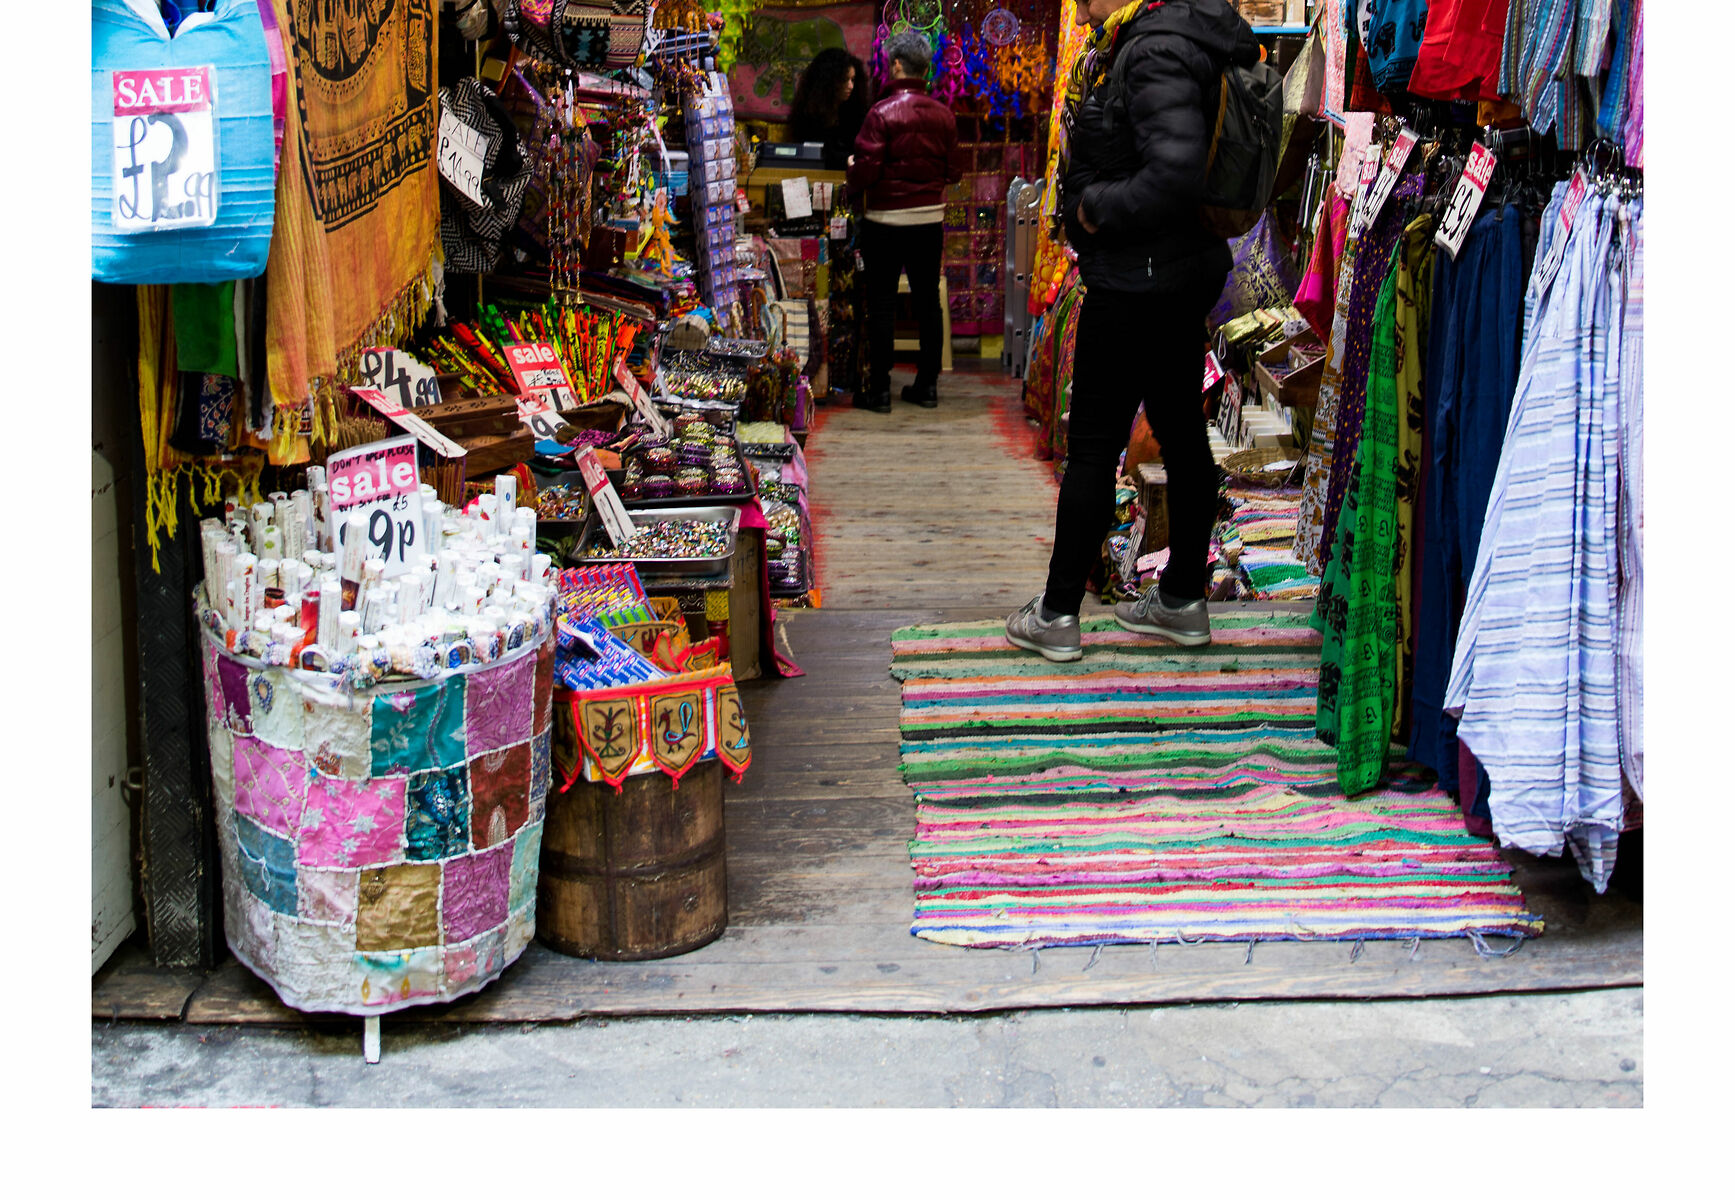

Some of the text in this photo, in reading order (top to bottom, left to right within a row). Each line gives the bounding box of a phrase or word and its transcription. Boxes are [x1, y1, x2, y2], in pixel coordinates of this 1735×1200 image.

[118, 75, 204, 108] SALE
[1466, 150, 1493, 186] sale
[513, 343, 554, 364] sale
[333, 455, 361, 474] DON'T
[387, 445, 414, 459] PLEASE
[331, 455, 414, 503] sale
